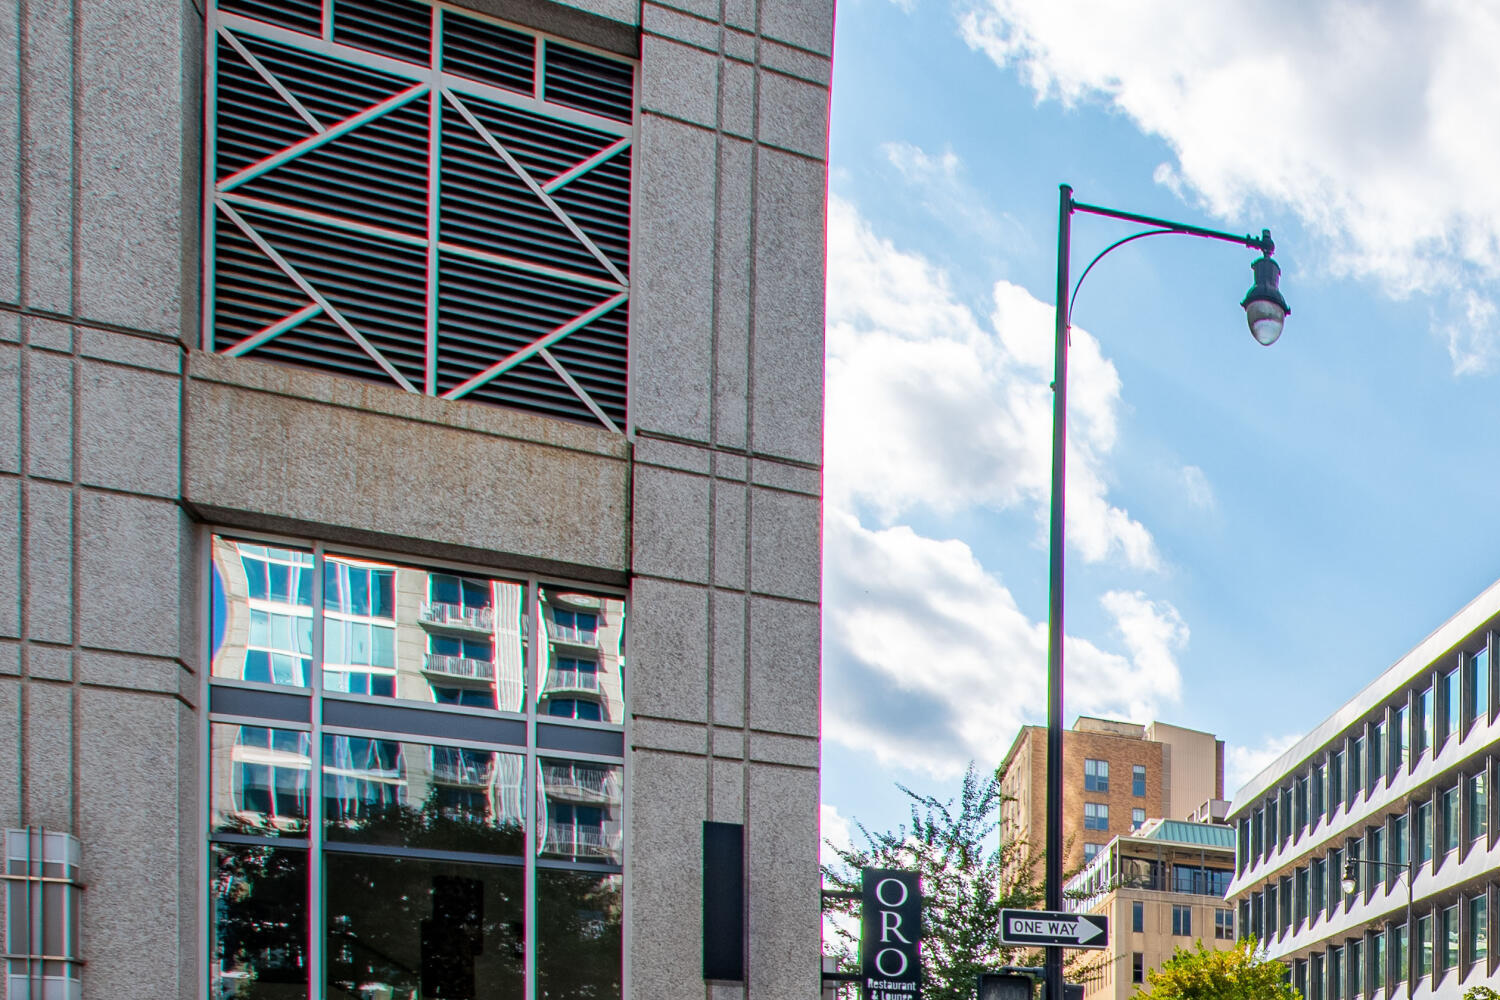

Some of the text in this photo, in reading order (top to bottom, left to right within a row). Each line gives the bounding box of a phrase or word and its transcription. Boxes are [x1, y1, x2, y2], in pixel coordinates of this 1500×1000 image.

[876, 878, 912, 976] ORO
[1013, 920, 1079, 936] ONE WAY
[867, 978, 916, 991] Restaurant
